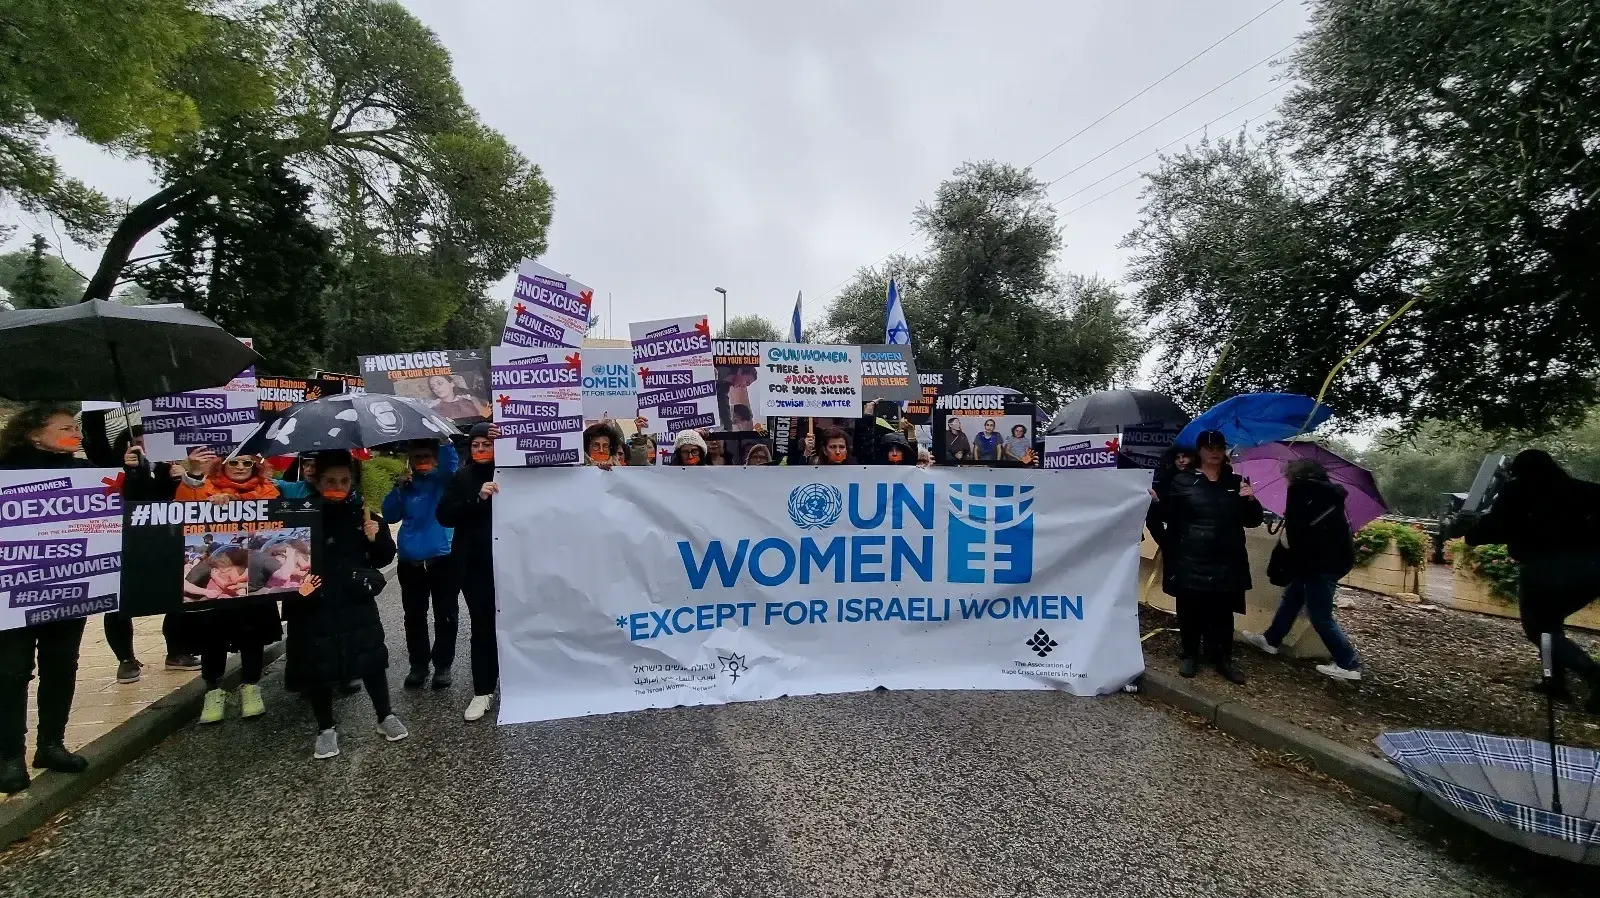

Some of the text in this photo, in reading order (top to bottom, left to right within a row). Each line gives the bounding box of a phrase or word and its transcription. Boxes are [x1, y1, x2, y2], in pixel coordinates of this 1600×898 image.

[516, 280, 587, 317] #NOEXCUSE
[518, 314, 562, 341] #UNLESS
[632, 335, 708, 359] #NOEXCUSE
[364, 351, 451, 372] #NOEXCUSE
[715, 356, 727, 364] FOR
[728, 356, 743, 364] YOUR
[403, 369, 423, 378] YOUR
[424, 367, 452, 376] SILENCE
[606, 364, 628, 376] UN
[766, 364, 800, 373] THERE
[260, 378, 307, 389] Sami Bahous
[491, 368, 578, 386] #NOEXCUSE
[582, 377, 628, 388] OMEN
[645, 374, 691, 385] #UNLESS
[784, 375, 850, 385] #NOEXCUSE
[880, 377, 908, 386] SILENCE
[638, 384, 714, 406] #ISRAELIWOMEN
[769, 384, 788, 393] FOR
[792, 386, 817, 395] YOUR
[154, 396, 224, 409] #UNLESS
[260, 401, 274, 411] FOR
[822, 400, 851, 408] MATTER
[936, 394, 1005, 409] #NOEXCUSE
[503, 403, 557, 417] #UNLESS
[660, 406, 695, 415] #RAPED
[143, 410, 256, 431] #ISRAELIWOMEN
[498, 418, 580, 436] ISRAELIWOMEN
[669, 415, 713, 430] #BYHAMAS
[178, 432, 228, 442] #RAPED
[519, 438, 558, 449] #RAPED
[528, 451, 577, 465] #BYHAMAS
[1044, 450, 1115, 468] #NOEXCUSE
[0, 493, 121, 520] OEXCUSE
[131, 500, 269, 526] #NOEXCUSE
[848, 483, 935, 530] UN
[184, 521, 285, 536] FOR YOUR SILENCE
[676, 535, 935, 590] WOMEN
[0, 556, 122, 588] RAELIWOMEN
[15, 586, 83, 603] #RAPED
[30, 598, 113, 624] #BYHAMAS
[764, 599, 829, 626] FOR
[837, 597, 950, 623] ISRAELI
[959, 595, 1084, 620] WOMEN
